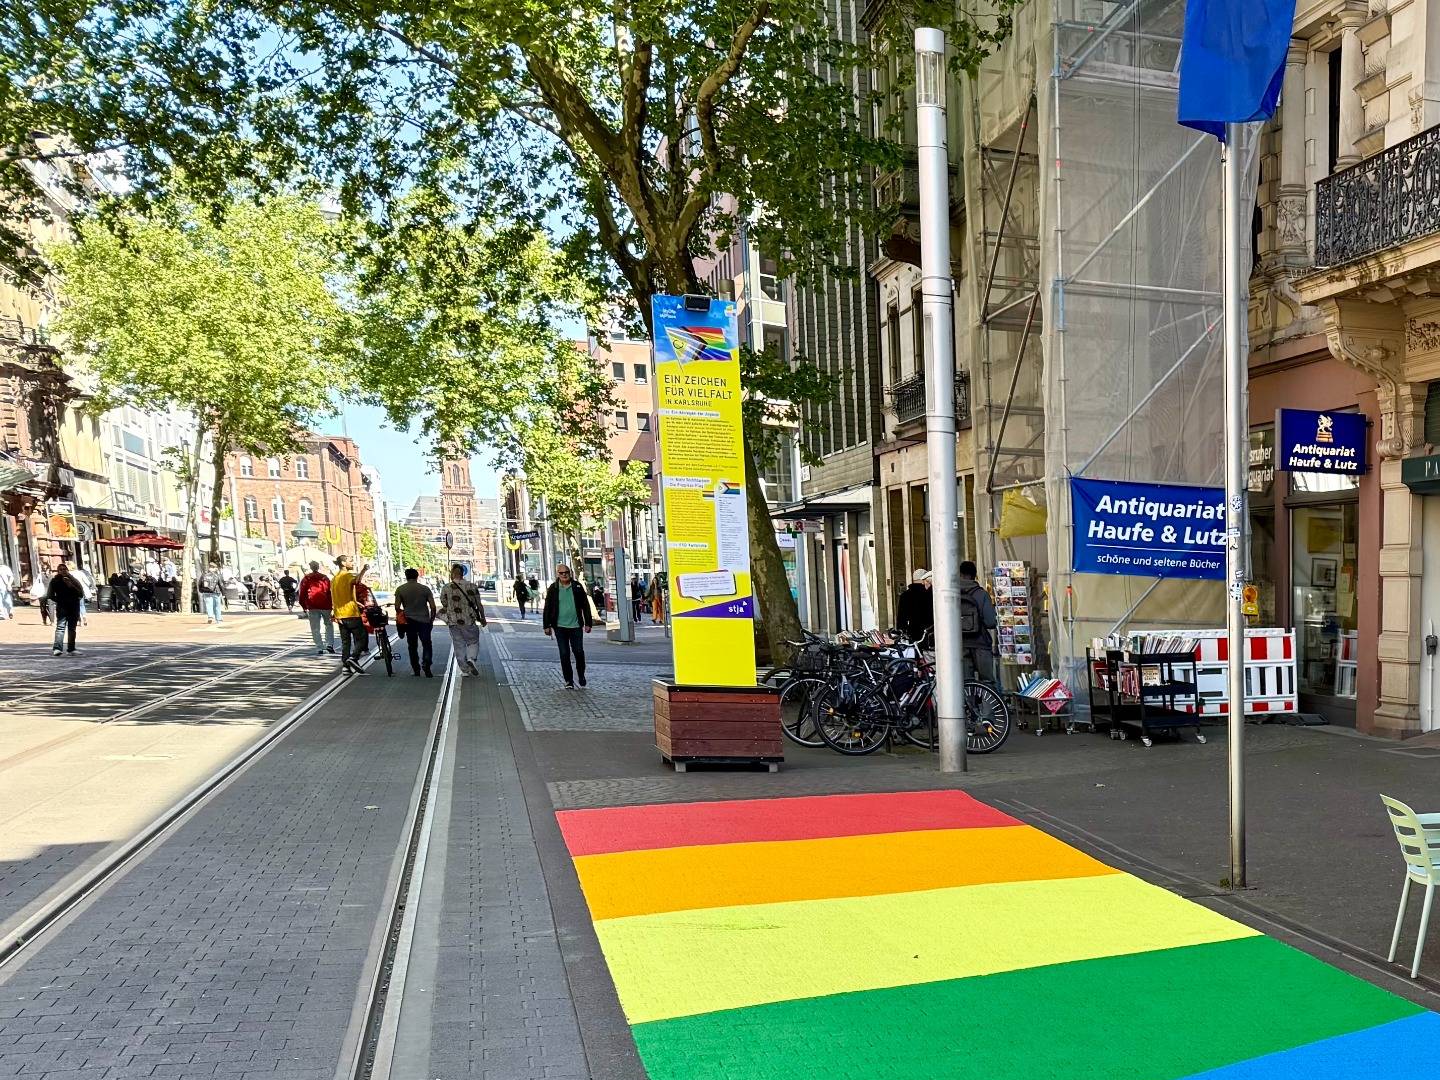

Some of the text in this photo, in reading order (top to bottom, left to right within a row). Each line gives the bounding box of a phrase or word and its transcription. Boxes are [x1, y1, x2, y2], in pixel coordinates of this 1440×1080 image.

[664, 374, 726, 387] EIN ZEICHEN
[665, 385, 732, 400] FÜR VIELFALT
[1250, 444, 1272, 462] sruher
[1292, 443, 1355, 458] Antiquariat
[1289, 456, 1358, 471] Haufe & Lutz
[1248, 466, 1274, 484] quariat
[1095, 495, 1226, 521] Antiquariat
[1087, 520, 1154, 544] Haufe
[1161, 526, 1178, 544] &
[1184, 527, 1229, 547] Lutz
[1096, 554, 1221, 570] schöne und seltene Bücher
[728, 605, 744, 614] stja
